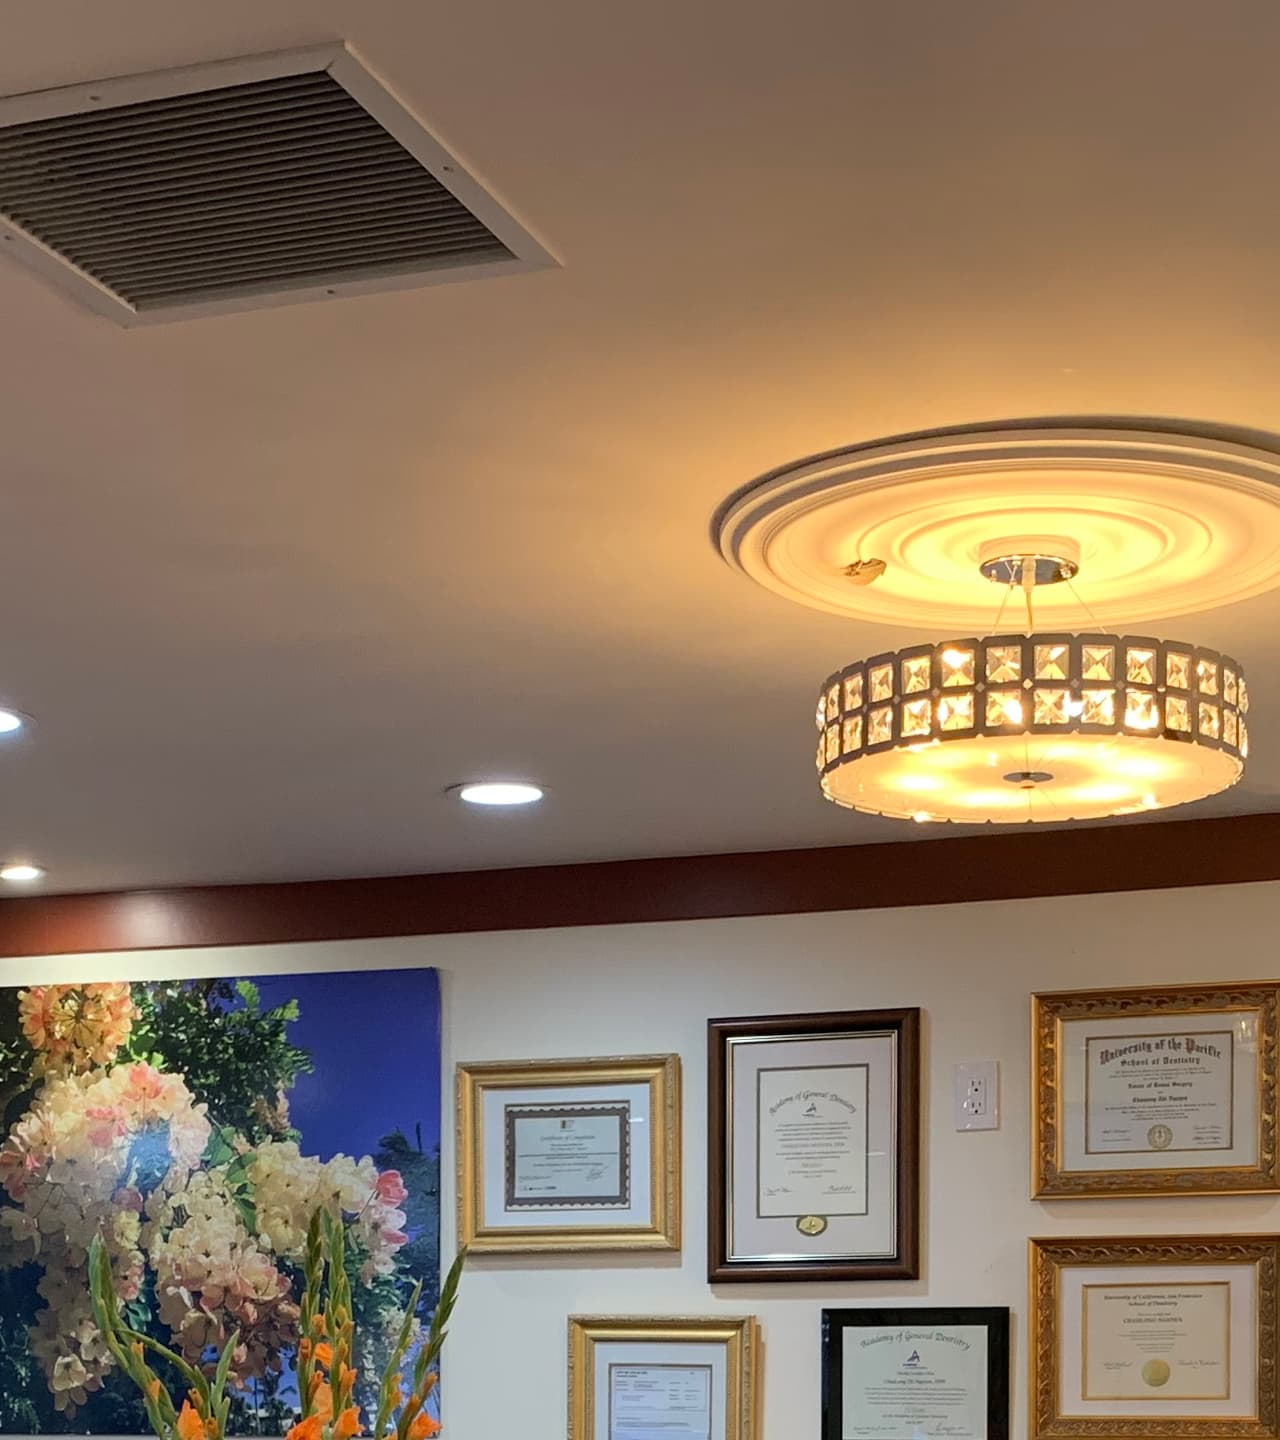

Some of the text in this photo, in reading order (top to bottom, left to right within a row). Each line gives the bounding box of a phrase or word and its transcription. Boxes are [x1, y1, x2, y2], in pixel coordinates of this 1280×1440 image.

[1100, 1037, 1222, 1065] University of the Pacific
